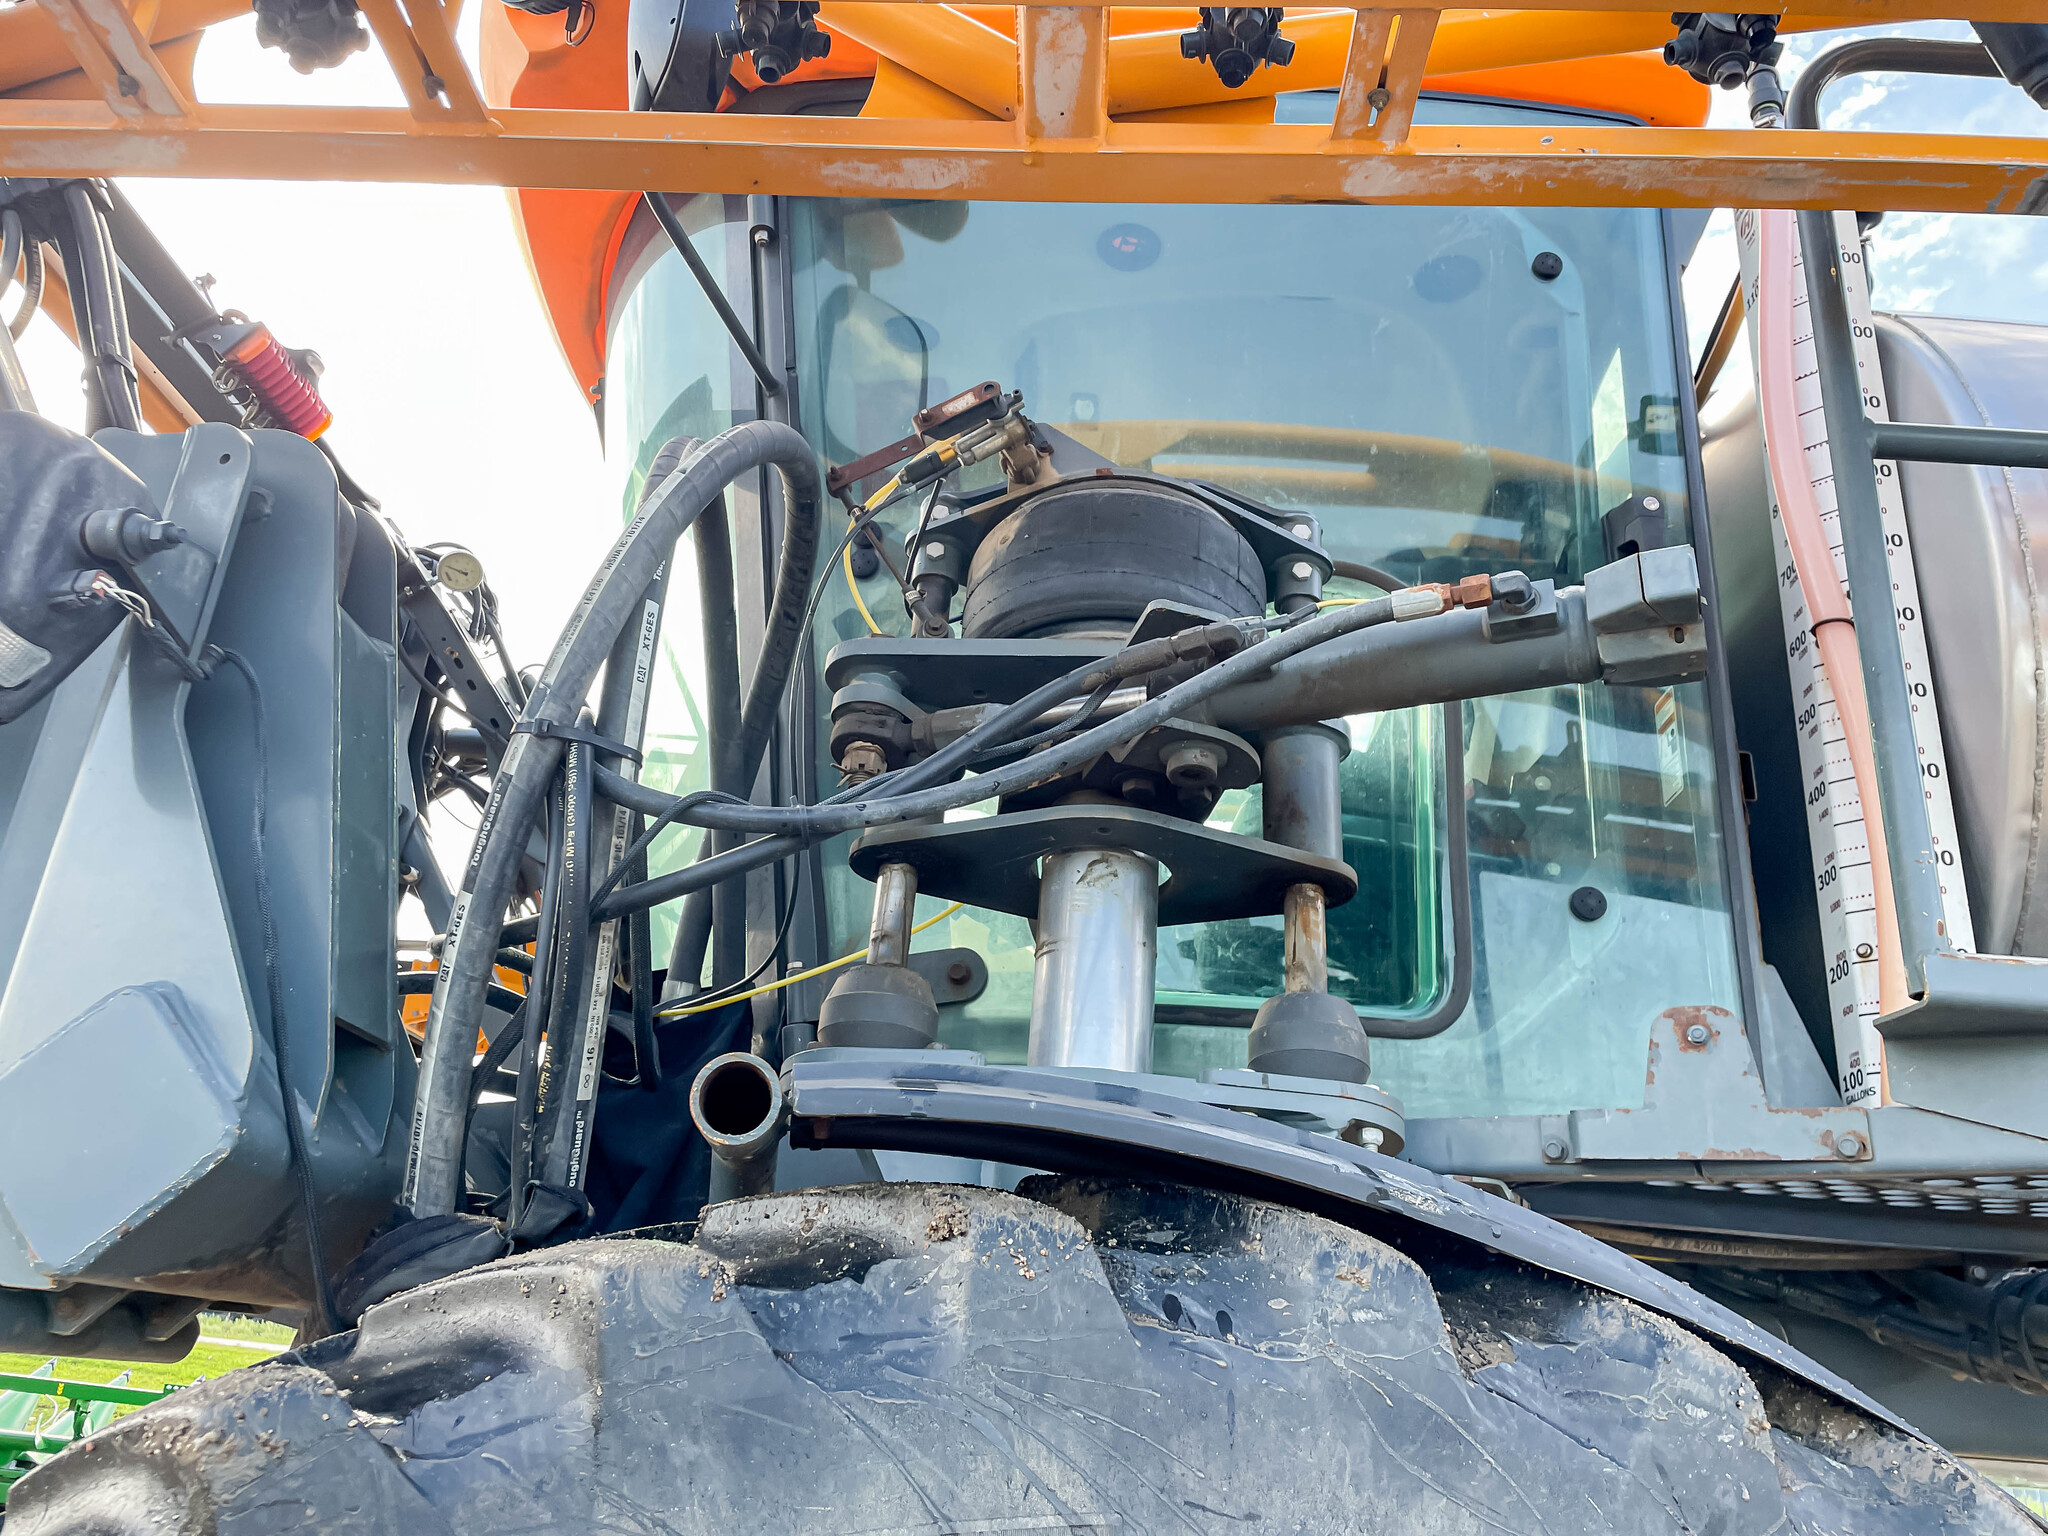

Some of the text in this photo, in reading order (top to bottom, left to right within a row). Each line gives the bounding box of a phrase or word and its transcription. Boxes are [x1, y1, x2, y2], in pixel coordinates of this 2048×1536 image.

[604, 549, 623, 571] MSHA
[642, 611, 656, 652] XT-6ES
[1789, 630, 1806, 658] 600
[1798, 703, 1815, 731] 500
[1808, 781, 1826, 806] 400
[565, 830, 576, 857] MPa
[1818, 865, 1837, 891] 300
[439, 903, 466, 984] CAT XT-6ES
[1829, 959, 1849, 985] 200
[1842, 1004, 1854, 1017] 600
[1850, 1057, 1861, 1069] 400
[1842, 1069, 1863, 1093] 100
[1845, 1086, 1876, 1105] GALLONS
[568, 1110, 584, 1188] oughGuard™
